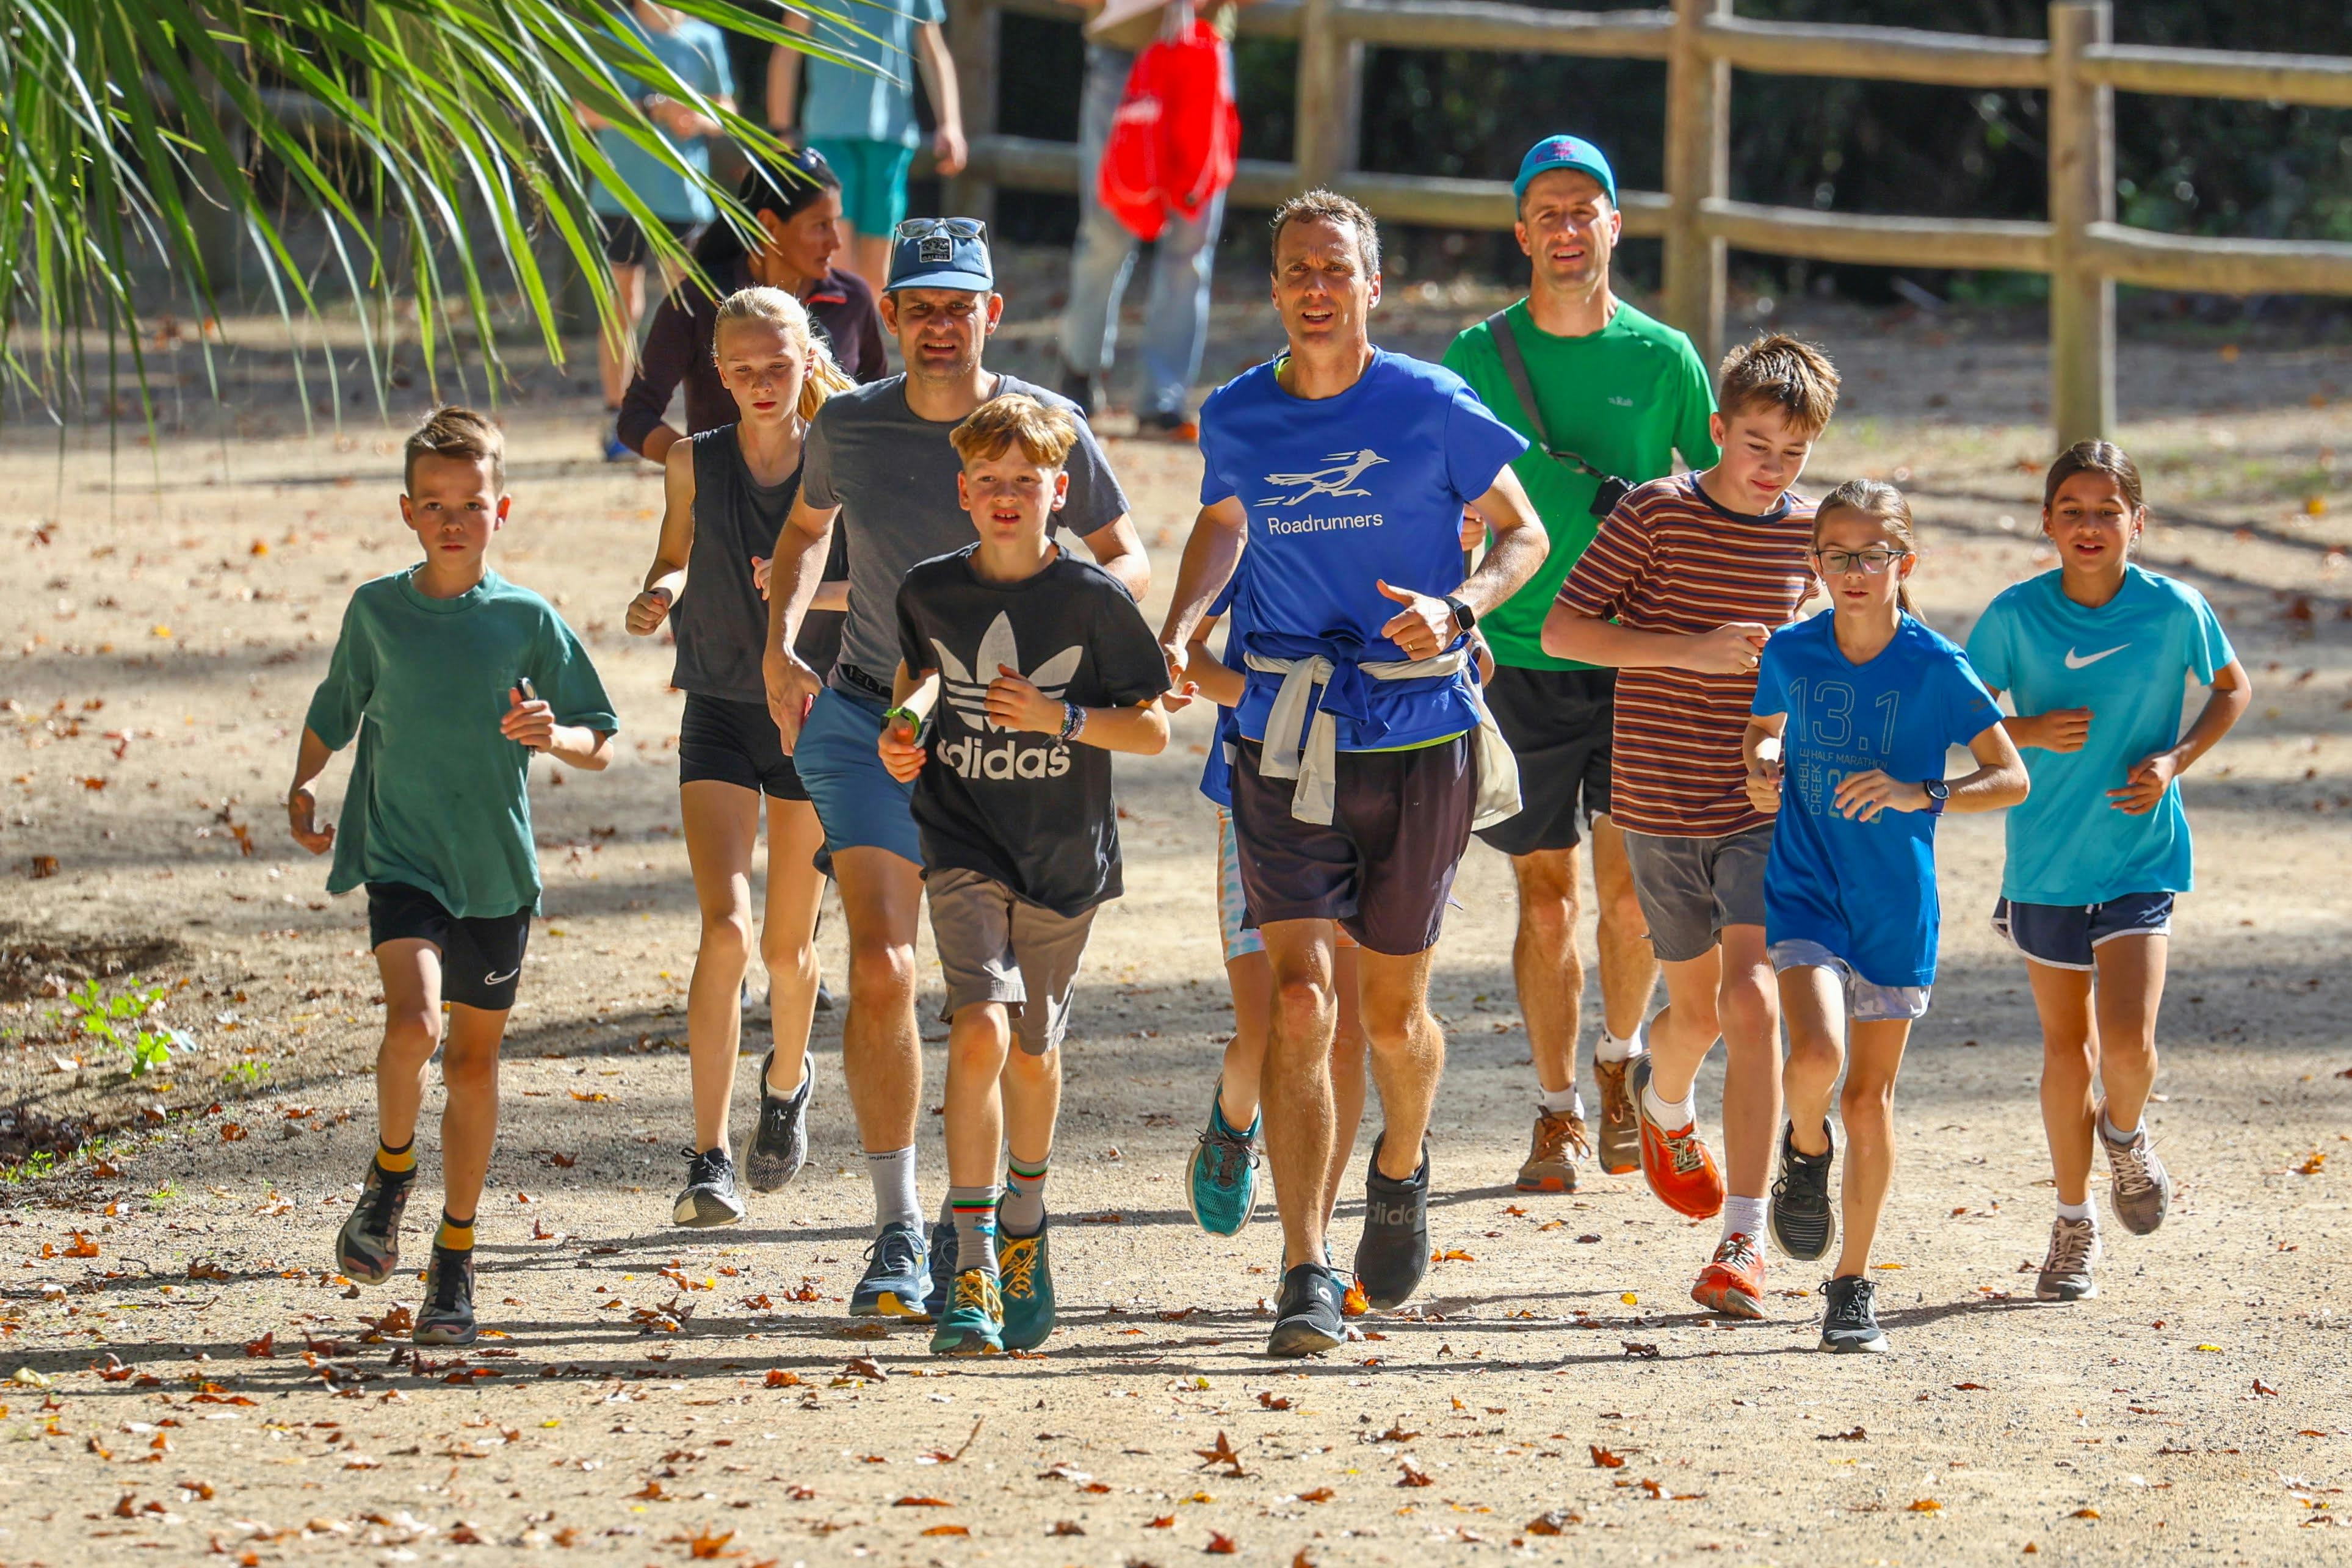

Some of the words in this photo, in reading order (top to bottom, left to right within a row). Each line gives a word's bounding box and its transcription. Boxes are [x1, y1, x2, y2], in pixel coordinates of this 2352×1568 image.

[1267, 513, 1383, 535] Roadrunners
[1789, 677, 1900, 755] 13.1
[1811, 749, 1834, 762] HALF
[1836, 753, 1889, 770] MARATHON
[1811, 763, 1823, 815] CREEK
